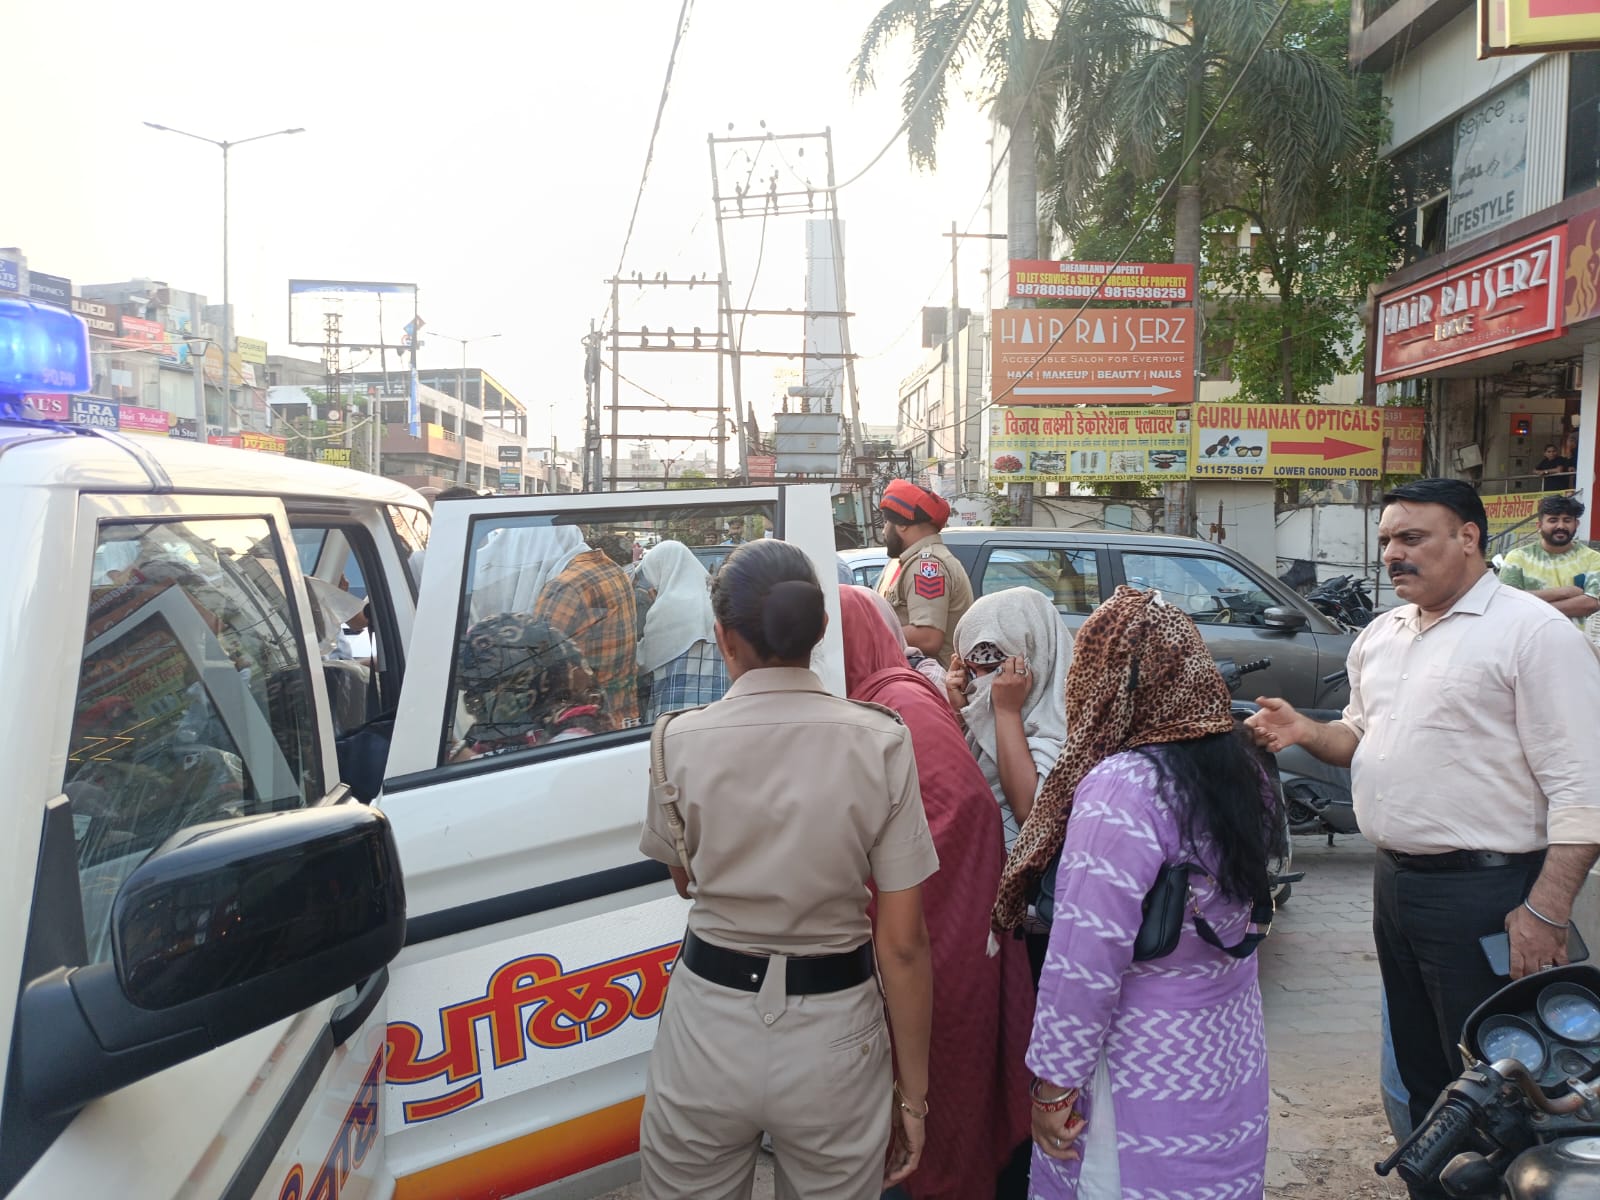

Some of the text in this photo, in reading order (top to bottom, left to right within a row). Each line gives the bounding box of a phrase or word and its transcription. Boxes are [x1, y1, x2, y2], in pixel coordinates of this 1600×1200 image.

[1016, 272, 1026, 283] TO
[1027, 272, 1039, 284] LET
[1039, 273, 1070, 285] SERVICE
[1077, 274, 1095, 286] SALE
[1140, 276, 1150, 287] OF
[1150, 277, 1187, 288] PROPERTY
[1103, 286, 1187, 299] 9815936259
[1042, 370, 1089, 379] MAKEUP
[1097, 370, 1141, 379] BEAUTY
[1149, 369, 1183, 379] NAILS
[1005, 409, 1040, 436] विजय
[1077, 411, 1129, 436] डेकोरेशन
[1197, 405, 1242, 429] GURU
[1247, 406, 1301, 431] NANAK
[1305, 408, 1381, 432] OPTICALS
[323, 448, 351, 461] FANCY
[1196, 465, 1379, 477] 9115758167 LOWER GROUND FLOOR
